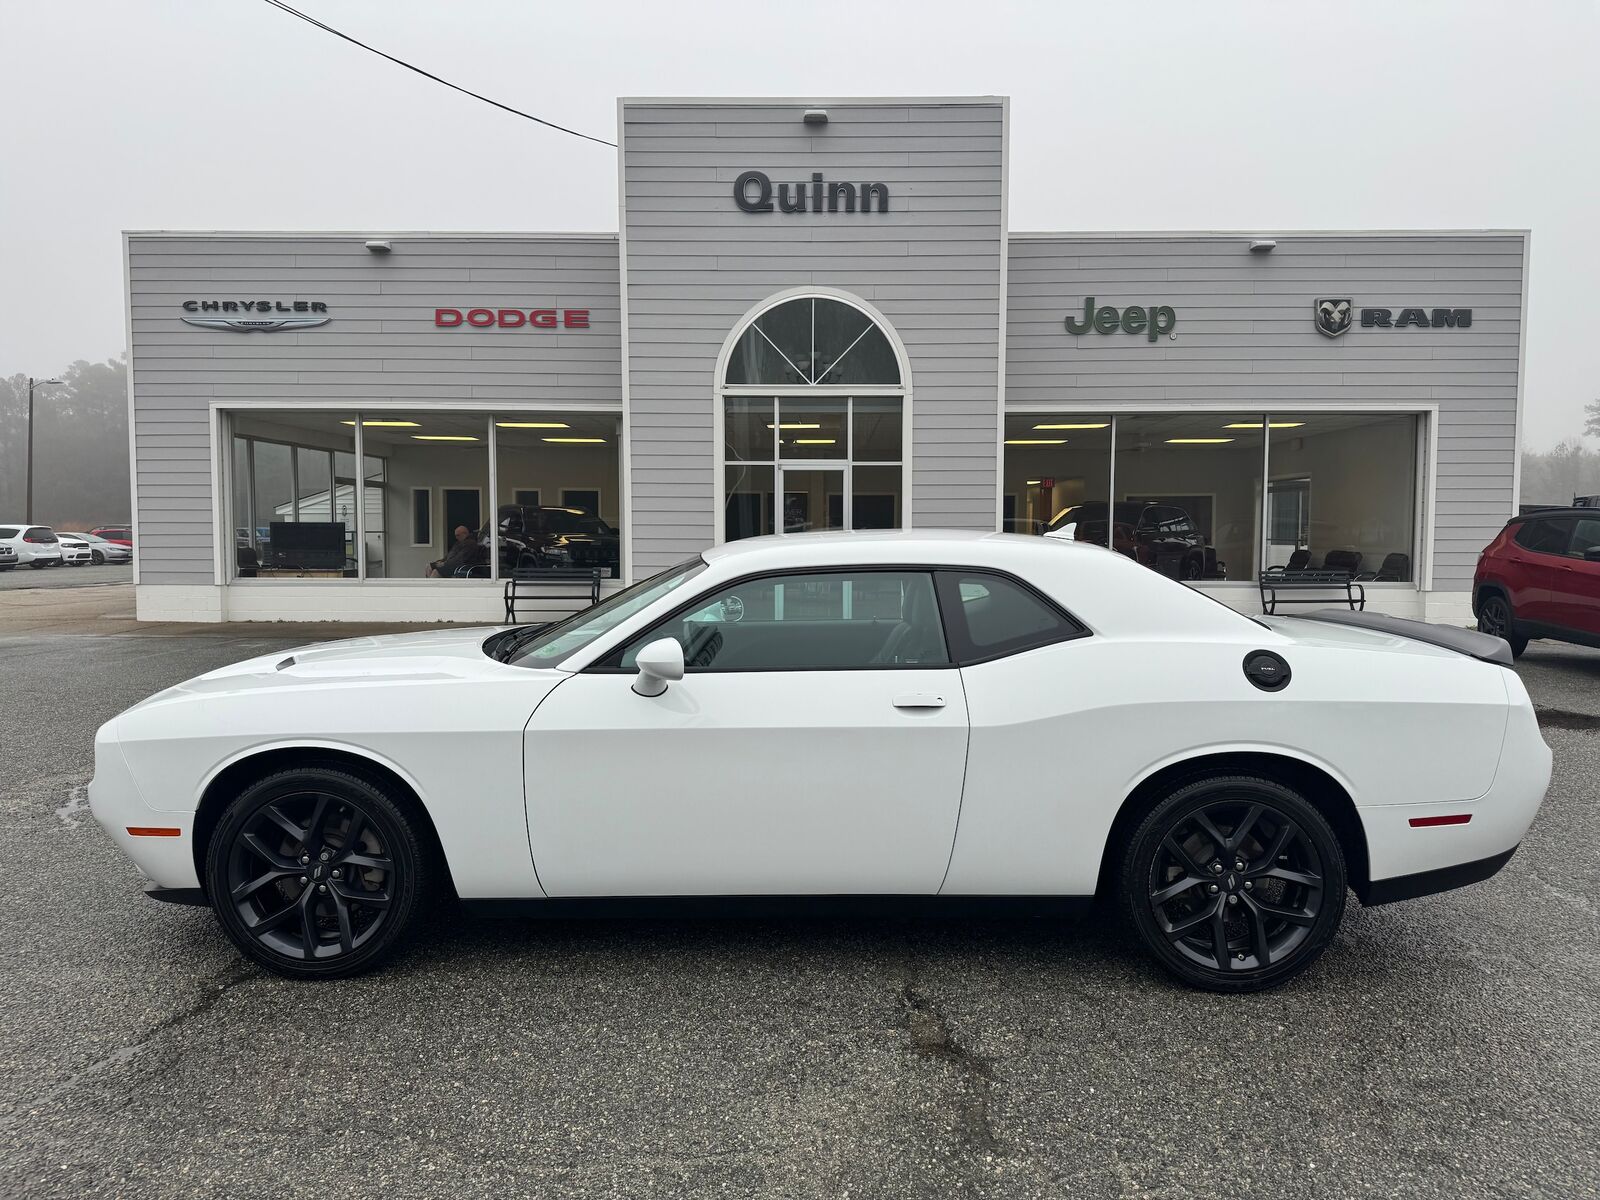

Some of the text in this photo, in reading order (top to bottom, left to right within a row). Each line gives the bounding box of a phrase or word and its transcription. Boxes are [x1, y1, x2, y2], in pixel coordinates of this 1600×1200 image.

[733, 170, 889, 213] Quinn
[182, 300, 327, 313] CHRYSLER
[435, 308, 590, 328] DODGE
[1064, 297, 1176, 342] Jeep
[1361, 308, 1473, 328] RAM
